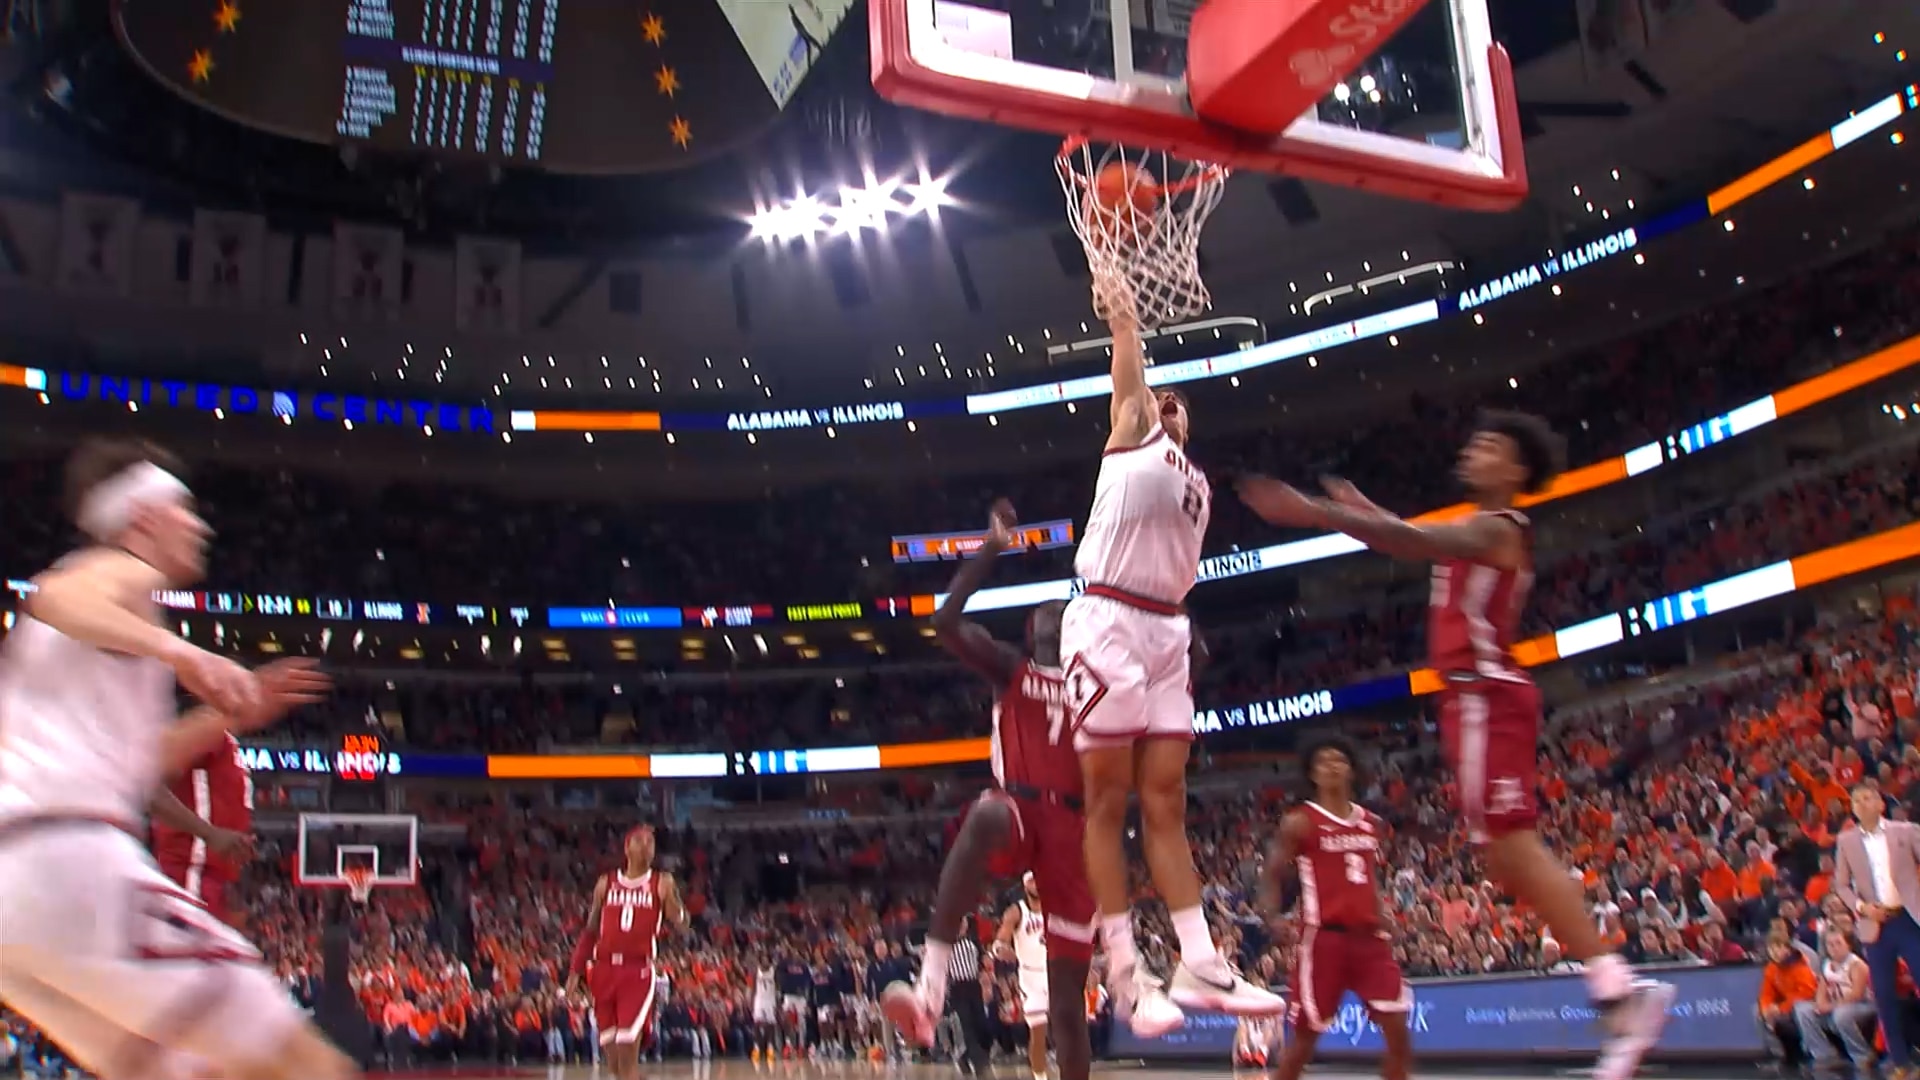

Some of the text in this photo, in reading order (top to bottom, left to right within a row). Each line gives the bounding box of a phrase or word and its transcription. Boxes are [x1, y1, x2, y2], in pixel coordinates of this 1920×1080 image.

[1458, 265, 1543, 311] ALABAMA
[1561, 228, 1638, 272] ILLINOIS
[60, 371, 495, 434] UNITED CENTER
[727, 409, 812, 431] ALABAMA
[833, 402, 904, 425] ILLINOIS
[1224, 708, 1246, 727] VS
[1248, 690, 1333, 727] ILLINOIS
[1344, 852, 1368, 885] 2
[620, 905, 634, 932] 0
